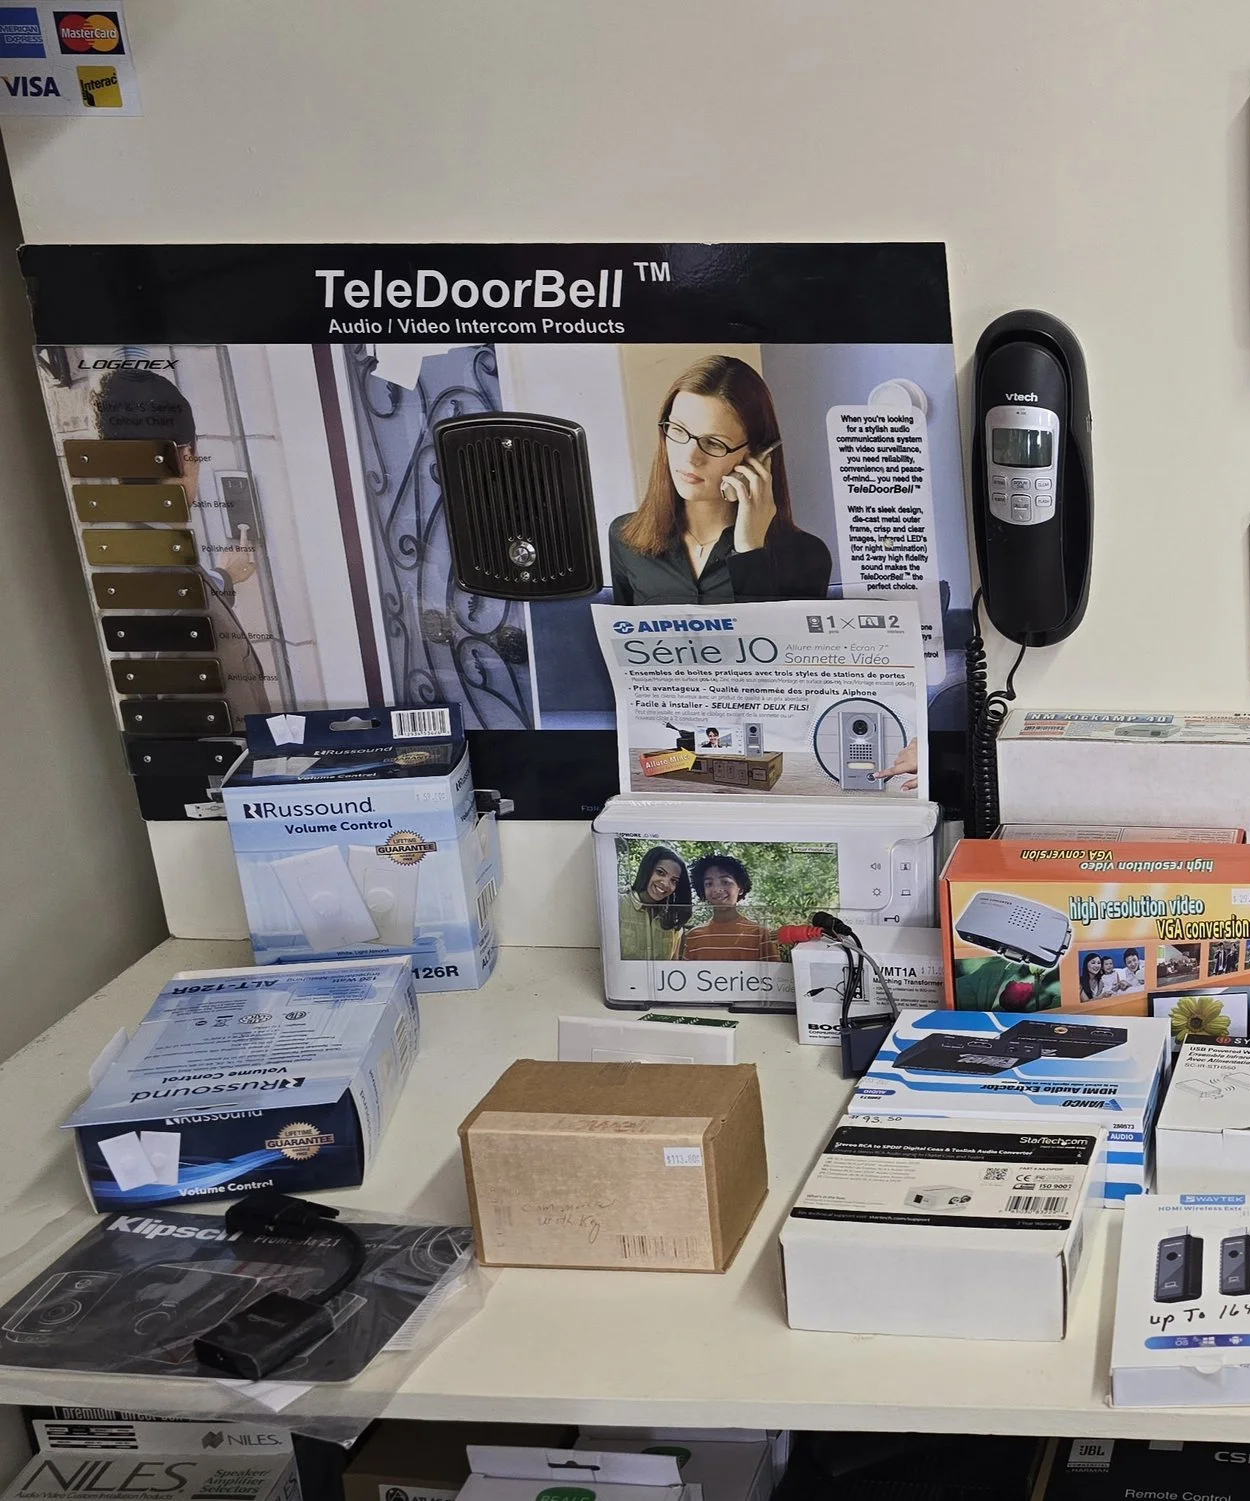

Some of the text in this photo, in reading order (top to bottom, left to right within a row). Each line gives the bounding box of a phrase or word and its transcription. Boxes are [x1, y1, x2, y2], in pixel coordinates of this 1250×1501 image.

[61, 28, 116, 38] MasterCard
[2, 76, 60, 96] VISA
[81, 75, 118, 97] Interac
[634, 262, 671, 282] TM
[316, 270, 623, 308] TeleDoorBell
[328, 318, 626, 334] Audio / Video Intercom Products
[78, 359, 180, 370] LOGENEX
[1006, 392, 1038, 402] vtech
[863, 416, 885, 424] you're
[887, 415, 914, 424] looking
[836, 435, 922, 444] communications system
[877, 445, 922, 454] surveillance,
[183, 454, 212, 463] Copper
[848, 484, 914, 494] TeleDoorBell
[192, 500, 234, 508] Satin Brass
[202, 544, 233, 552] Polished
[638, 618, 734, 633] AIPHONE
[827, 615, 836, 628] 1
[888, 615, 900, 628] 2
[624, 637, 778, 665] Série JO
[784, 652, 890, 665] Sonnette Vidéo
[711, 702, 760, 710] SEULEMENT
[324, 746, 392, 756] Russound
[264, 796, 376, 818] Russound
[285, 819, 393, 835] Volume Control
[378, 843, 434, 853] GUARANTEE
[1021, 850, 1113, 860] VGA conversion
[1079, 859, 1213, 872] high resolution video
[1069, 895, 1204, 925] high resolution video
[1156, 914, 1250, 939] VGA conversion
[657, 970, 774, 992] JO Series
[172, 980, 280, 995] ALT-126R
[162, 1066, 287, 1084] Volume Control
[131, 1078, 280, 1104] Russound
[980, 1084, 1117, 1095] HDMI Audio Extractor
[268, 1136, 332, 1147] GUARANTEE
[1019, 1136, 1088, 1146] StarTech.com
[179, 1180, 273, 1197] Volume Control
[1150, 1315, 1174, 1332] up
[1184, 1308, 1205, 1322] To
[228, 1434, 282, 1446] NILES
[1080, 1445, 1105, 1456] JBL
[21, 1460, 198, 1492] NILES
[215, 1468, 272, 1478] Speaker/
[204, 1477, 264, 1486] Amplifier
[200, 1485, 260, 1494] Selectors
[1124, 1489, 1232, 1501] Remote Control
